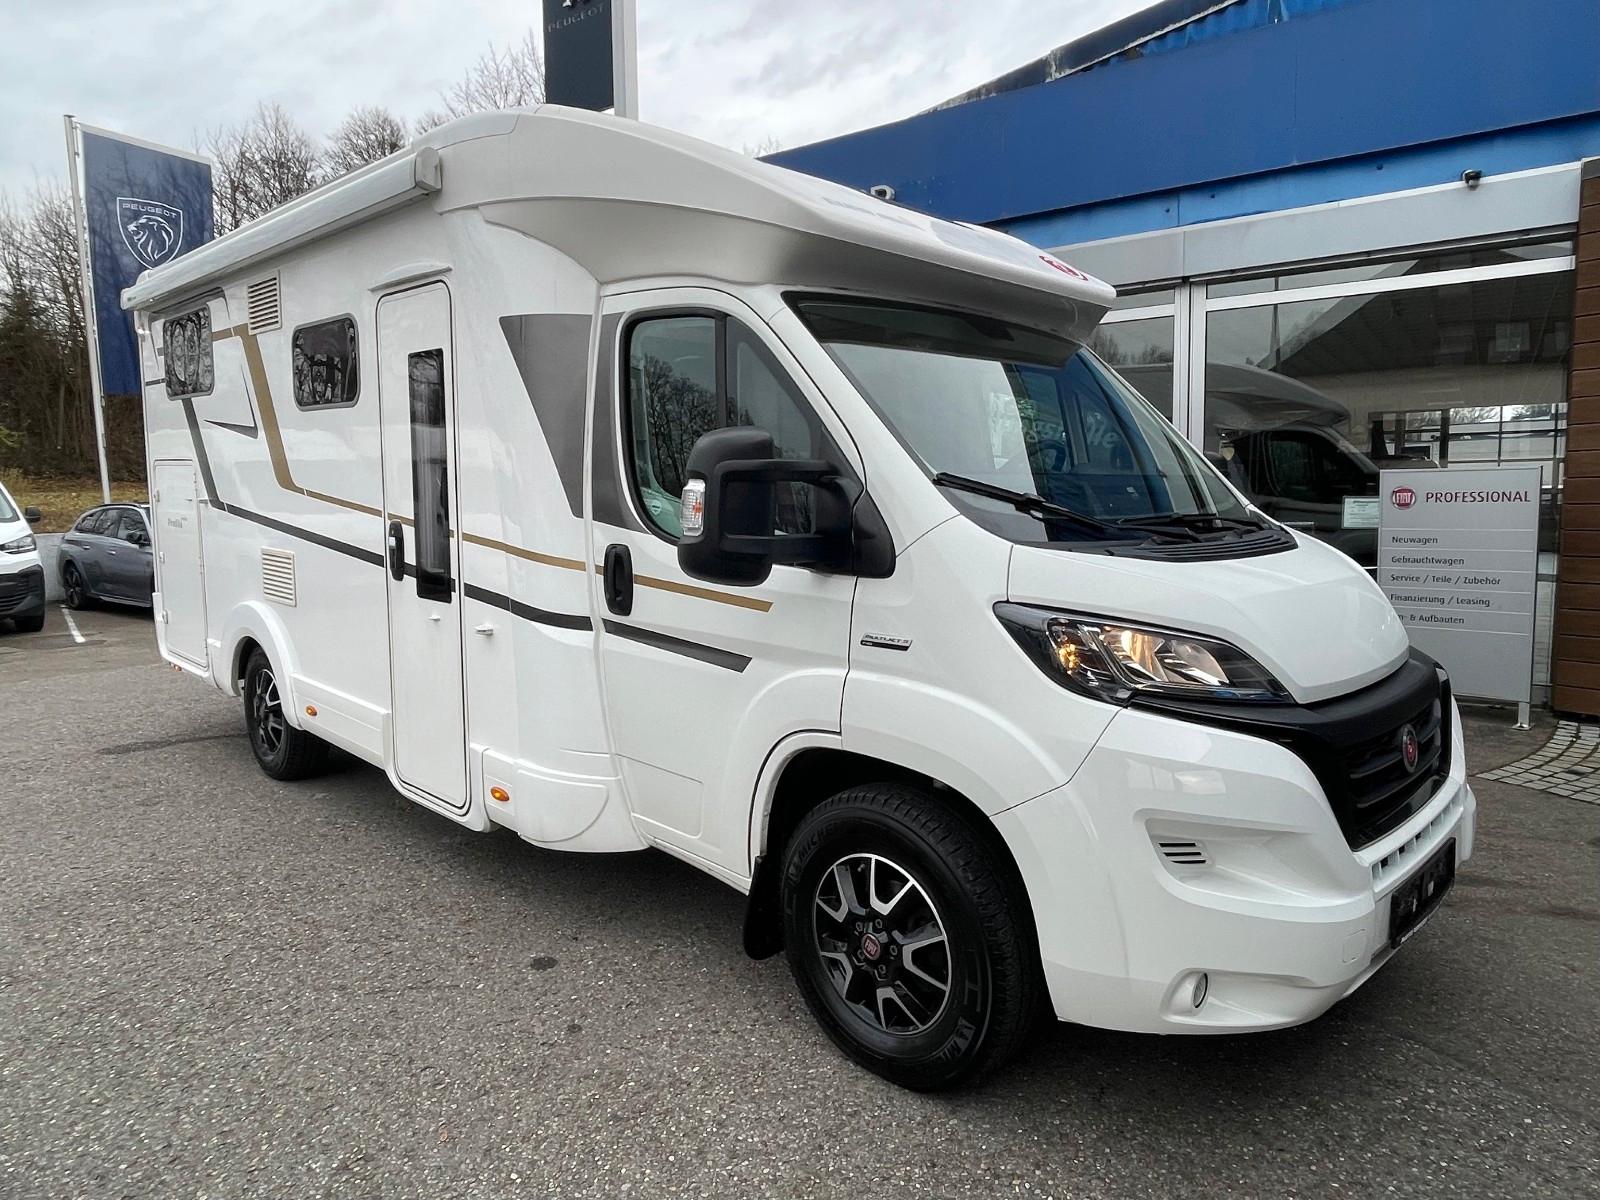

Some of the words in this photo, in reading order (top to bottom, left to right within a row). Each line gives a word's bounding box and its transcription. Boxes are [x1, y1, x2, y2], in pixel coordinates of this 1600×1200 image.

[122, 203, 177, 218] PEUGEOT
[1426, 490, 1531, 502] PROFESSIONAL
[1391, 536, 1438, 546] Neuwagen
[1391, 556, 1465, 567] Gebrauchtwagen
[1390, 574, 1420, 582] Service
[1432, 575, 1452, 584] Teile
[1463, 576, 1501, 585] Zubehör
[1390, 593, 1445, 606] Finanzierung
[1456, 597, 1490, 608] Leasing
[1409, 614, 1417, 622] &
[1418, 615, 1465, 625] Aufbauten
